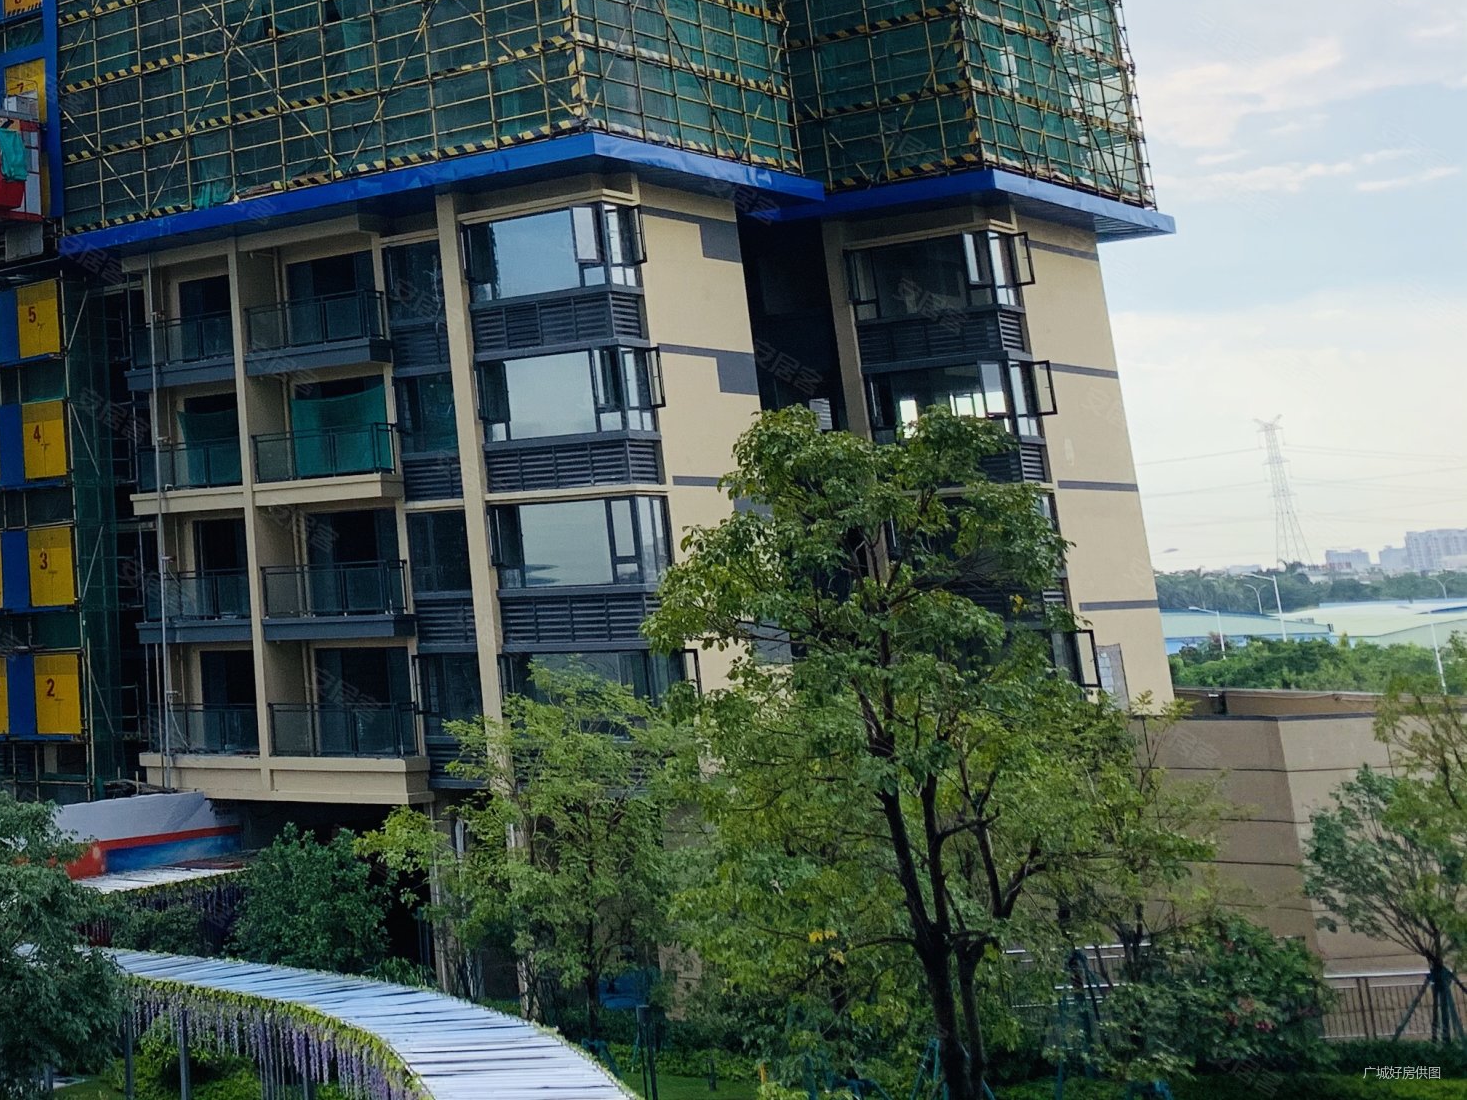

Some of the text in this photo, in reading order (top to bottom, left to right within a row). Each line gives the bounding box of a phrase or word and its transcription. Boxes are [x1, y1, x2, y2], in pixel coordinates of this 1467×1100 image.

[28, 306, 36, 323] 5
[33, 425, 41, 443] 4
[40, 552, 48, 570] 3
[46, 678, 55, 697] 2
